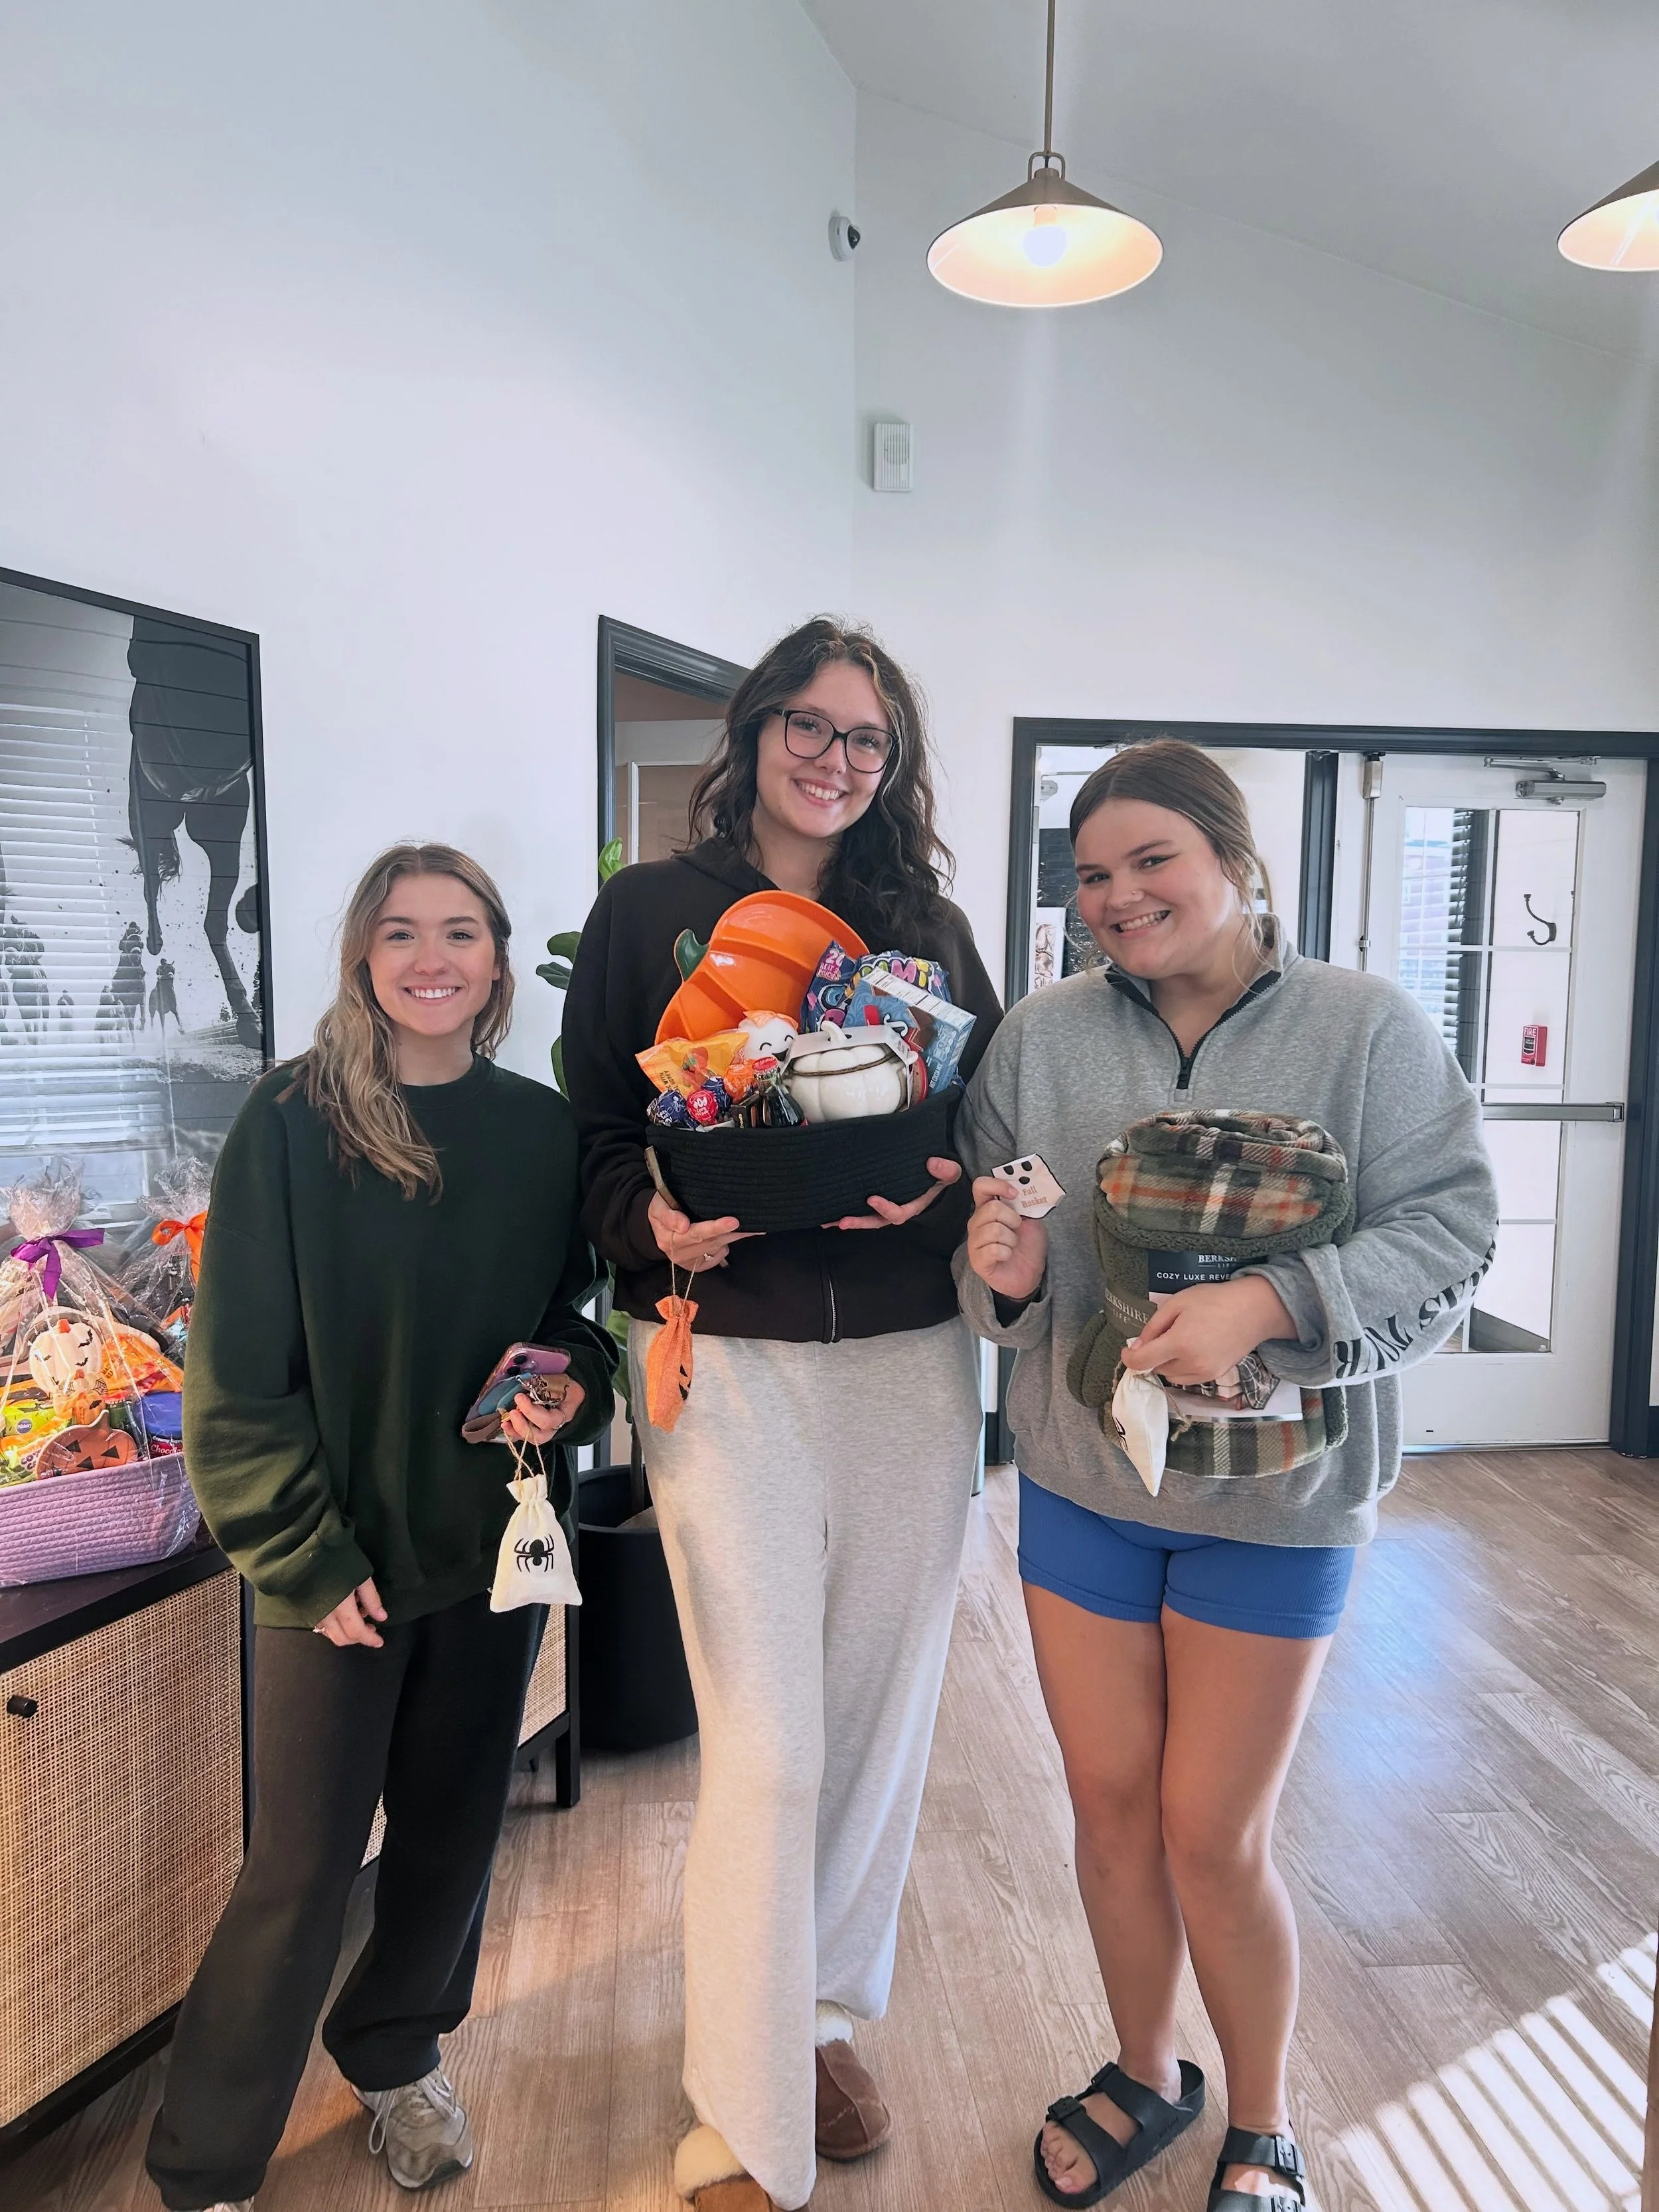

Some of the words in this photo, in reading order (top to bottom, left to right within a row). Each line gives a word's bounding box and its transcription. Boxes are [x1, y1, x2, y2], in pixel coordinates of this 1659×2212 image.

[1524, 1027, 1536, 1036] FIRE
[1022, 1185, 1038, 1196] Fall
[1022, 1197, 1048, 1208] Basket
